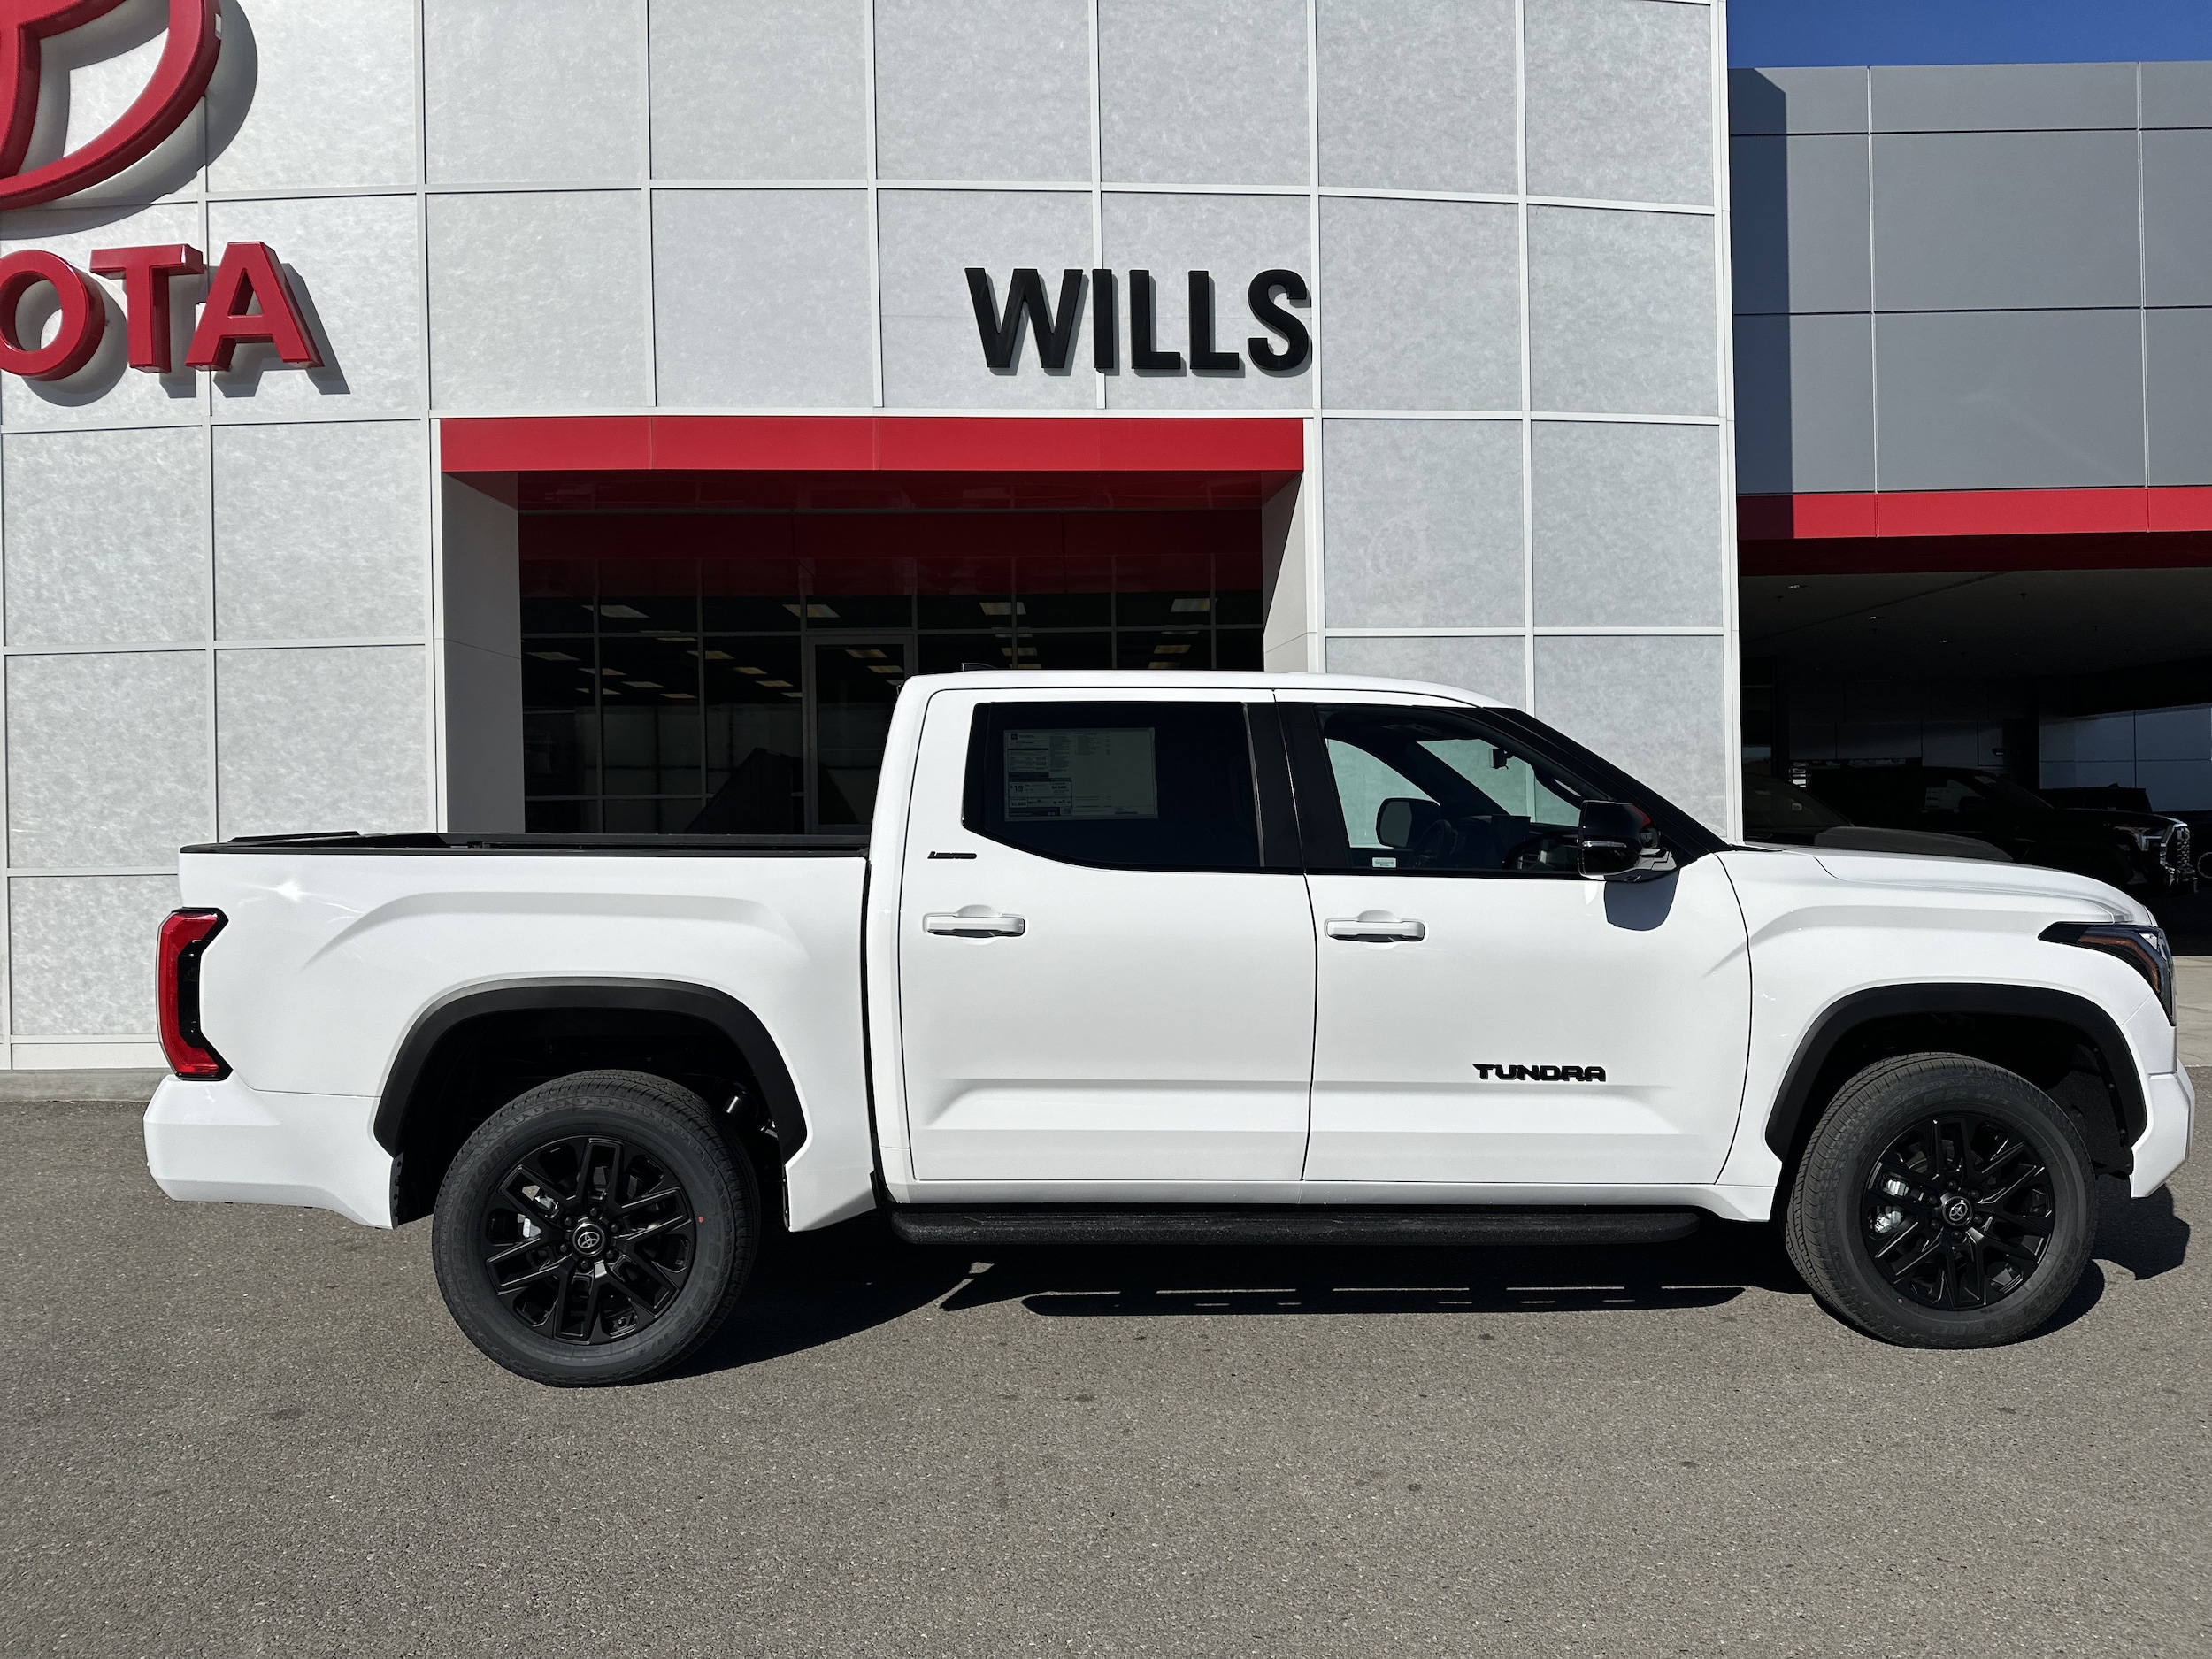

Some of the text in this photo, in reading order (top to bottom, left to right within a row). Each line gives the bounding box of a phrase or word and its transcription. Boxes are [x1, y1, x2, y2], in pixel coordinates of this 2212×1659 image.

[0, 241, 325, 381] OTA
[964, 267, 1311, 372] WILLS
[1472, 1064, 1607, 1082] TUNDRA
[450, 1133, 518, 1315] BRIDGESTONE
